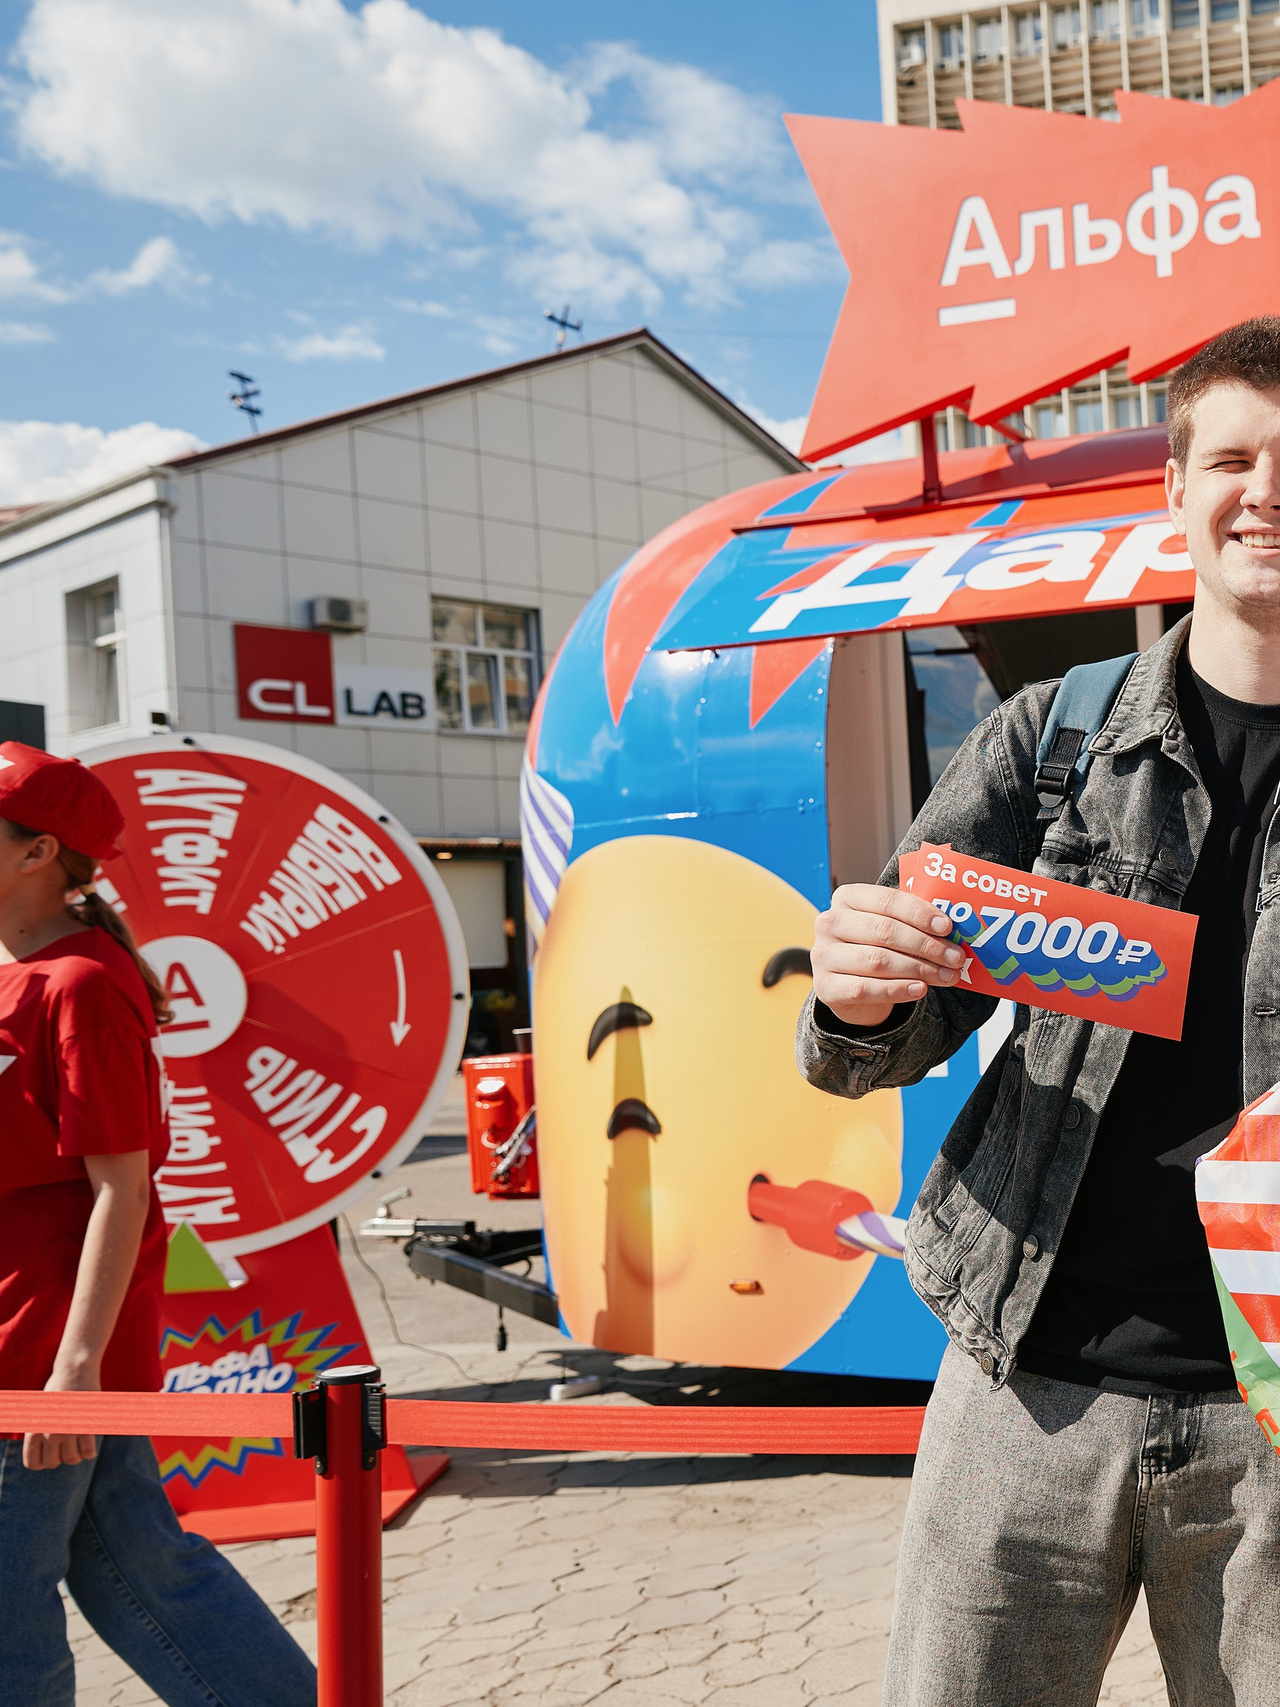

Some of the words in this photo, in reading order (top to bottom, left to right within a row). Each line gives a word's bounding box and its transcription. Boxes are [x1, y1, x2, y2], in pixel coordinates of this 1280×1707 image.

[940, 164, 1263, 287] Альфа
[248, 679, 331, 717] CL
[344, 687, 426, 719] LAB
[134, 769, 247, 914] АУТФИТ
[240, 803, 402, 954] ВЫБИРАЙ
[923, 852, 957, 884] За
[961, 869, 1048, 907] совет
[245, 1046, 387, 1183] СТИЛЬ
[162, 1342, 271, 1392] ЛЬФА
